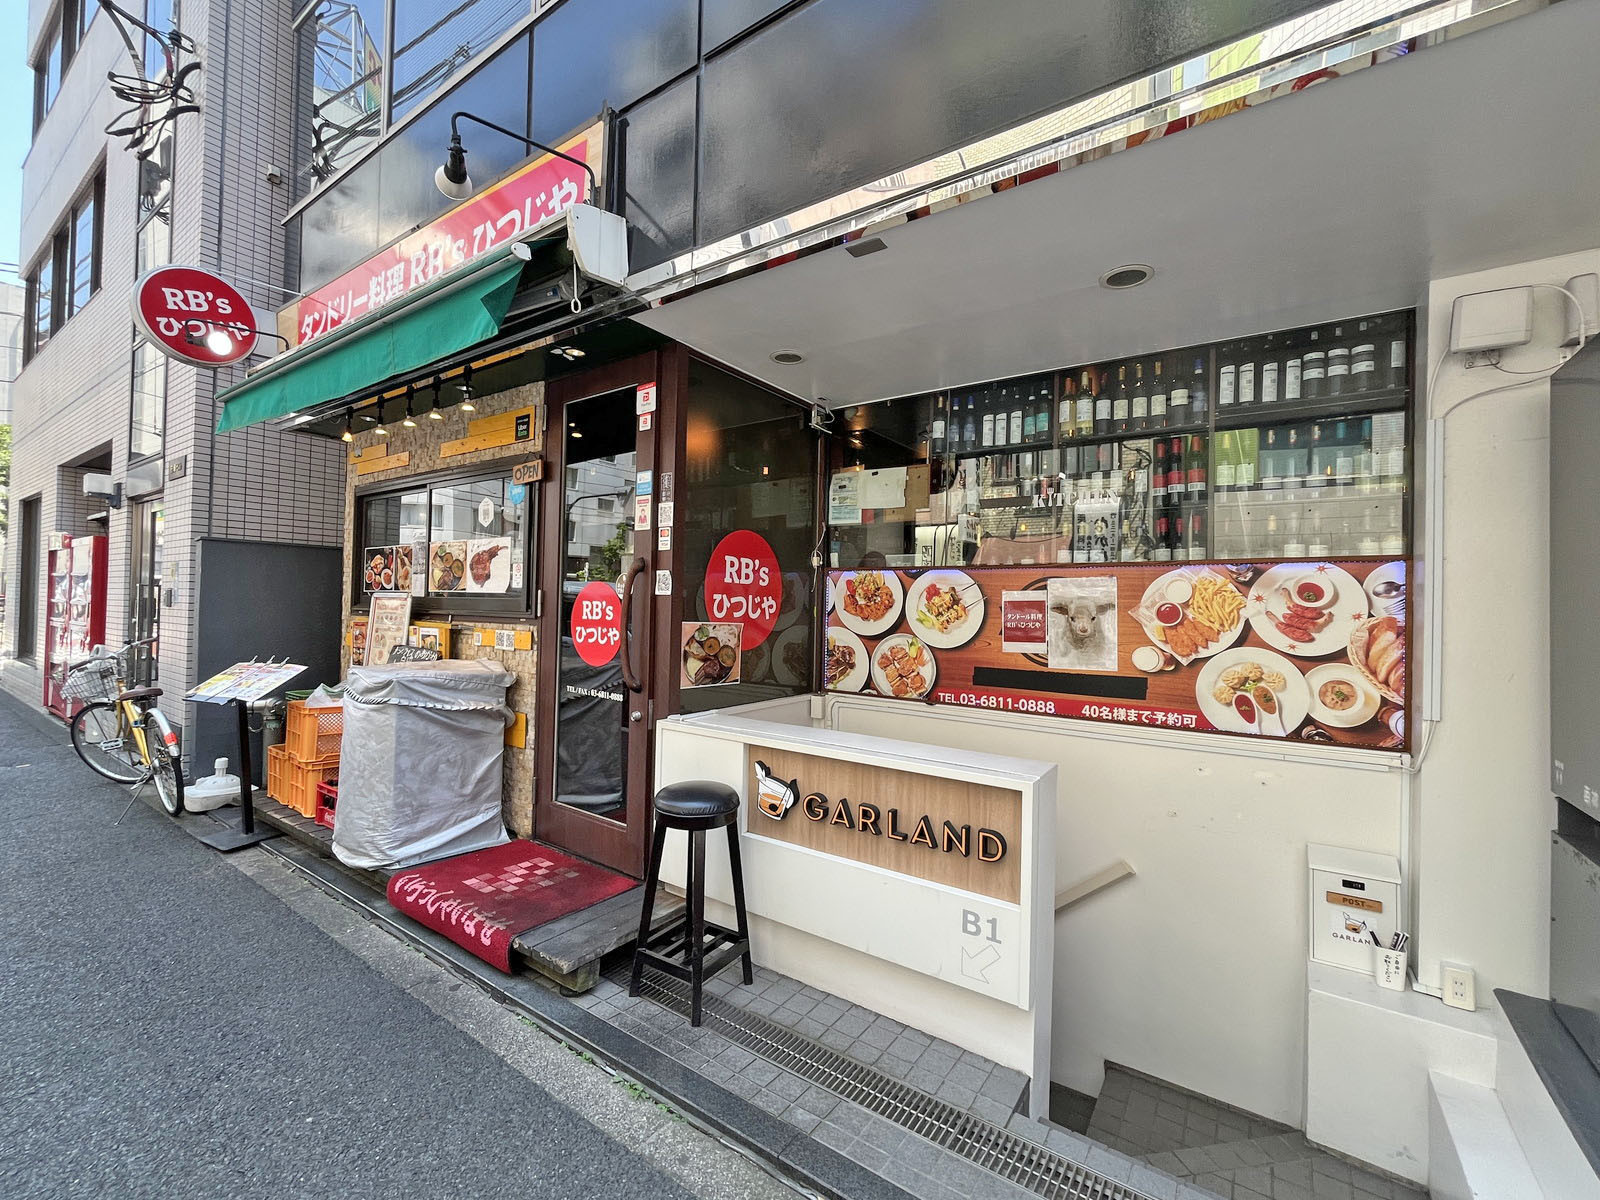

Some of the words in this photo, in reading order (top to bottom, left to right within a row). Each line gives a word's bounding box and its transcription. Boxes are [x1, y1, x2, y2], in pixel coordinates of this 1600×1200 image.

[300, 262, 405, 343] タンドリー料理
[410, 232, 465, 288] RB's
[472, 176, 579, 254] ひつじや
[161, 287, 233, 314] RB's
[514, 461, 540, 482] OPEN
[1032, 487, 1119, 508] KITCHEN
[723, 554, 770, 587] RB's
[581, 600, 614, 621] RB's
[712, 593, 777, 621] ひつじや
[1007, 613, 1043, 621] タンドール料理
[575, 626, 620, 646] ひつじや
[1081, 704, 1198, 728] 40名様まで予約可
[802, 792, 1008, 863] GARLAND
[394, 873, 515, 947] いらっしゃいませ
[1342, 897, 1367, 908] POST
[961, 908, 1003, 945] B1
[1331, 932, 1371, 946] GARLAN
